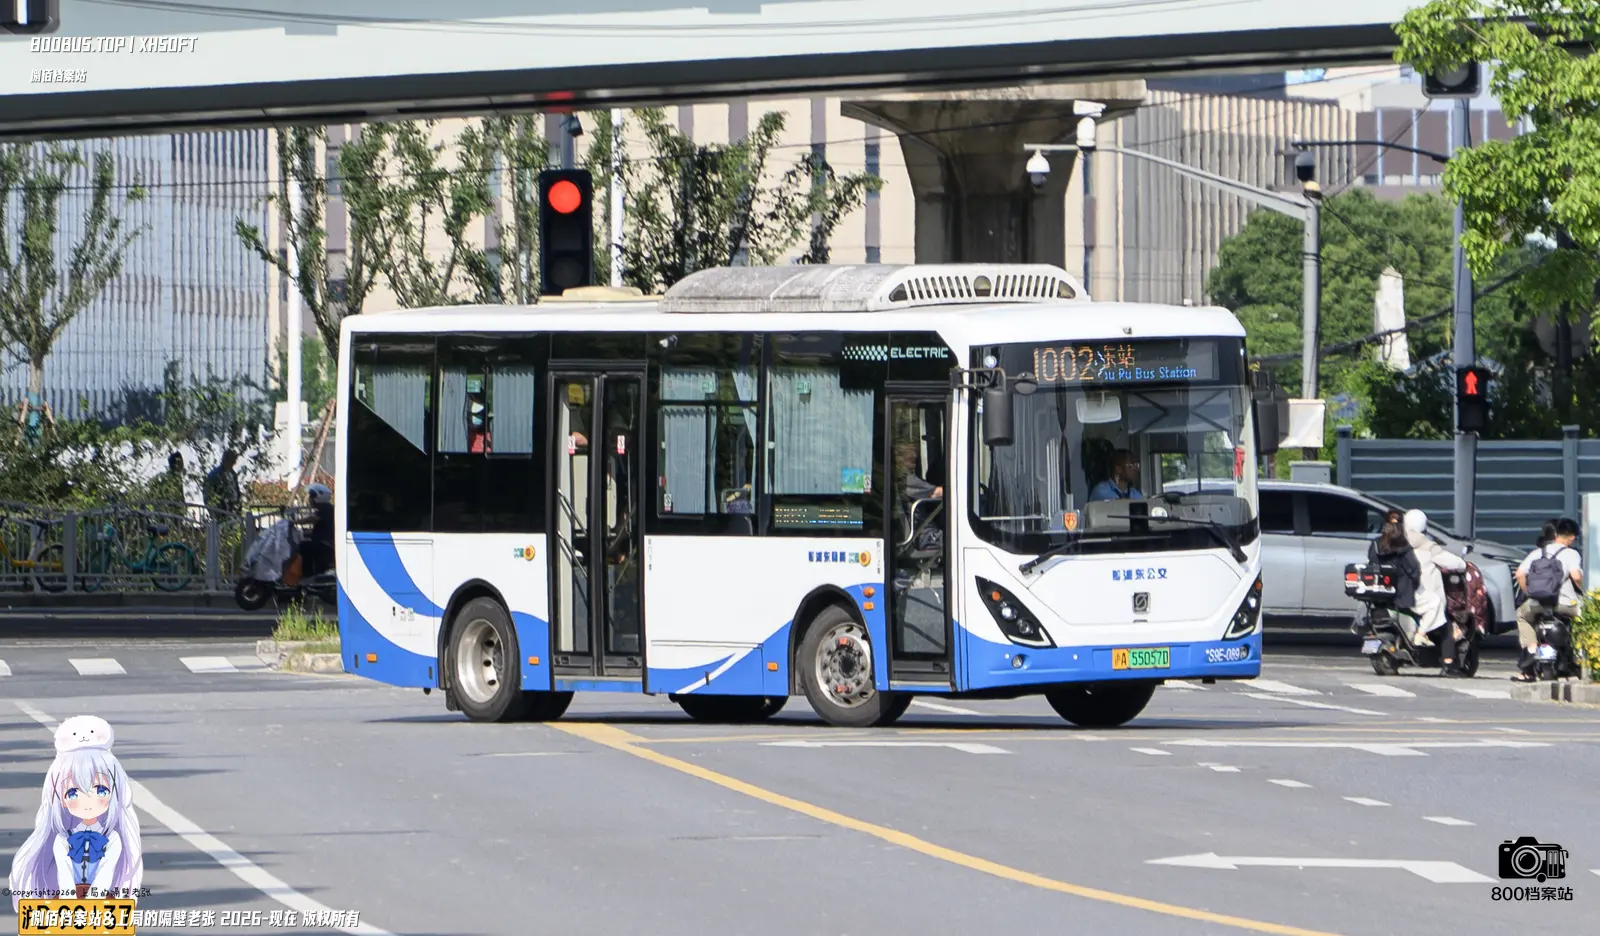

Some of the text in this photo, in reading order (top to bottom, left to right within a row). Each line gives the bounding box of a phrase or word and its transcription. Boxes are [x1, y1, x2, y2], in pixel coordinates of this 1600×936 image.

[890, 346, 949, 359] ELECTRIC
[1033, 346, 1095, 382] 1002
[1118, 367, 1132, 380] Pu
[1135, 367, 1156, 380] Bus
[1159, 365, 1197, 379] Station
